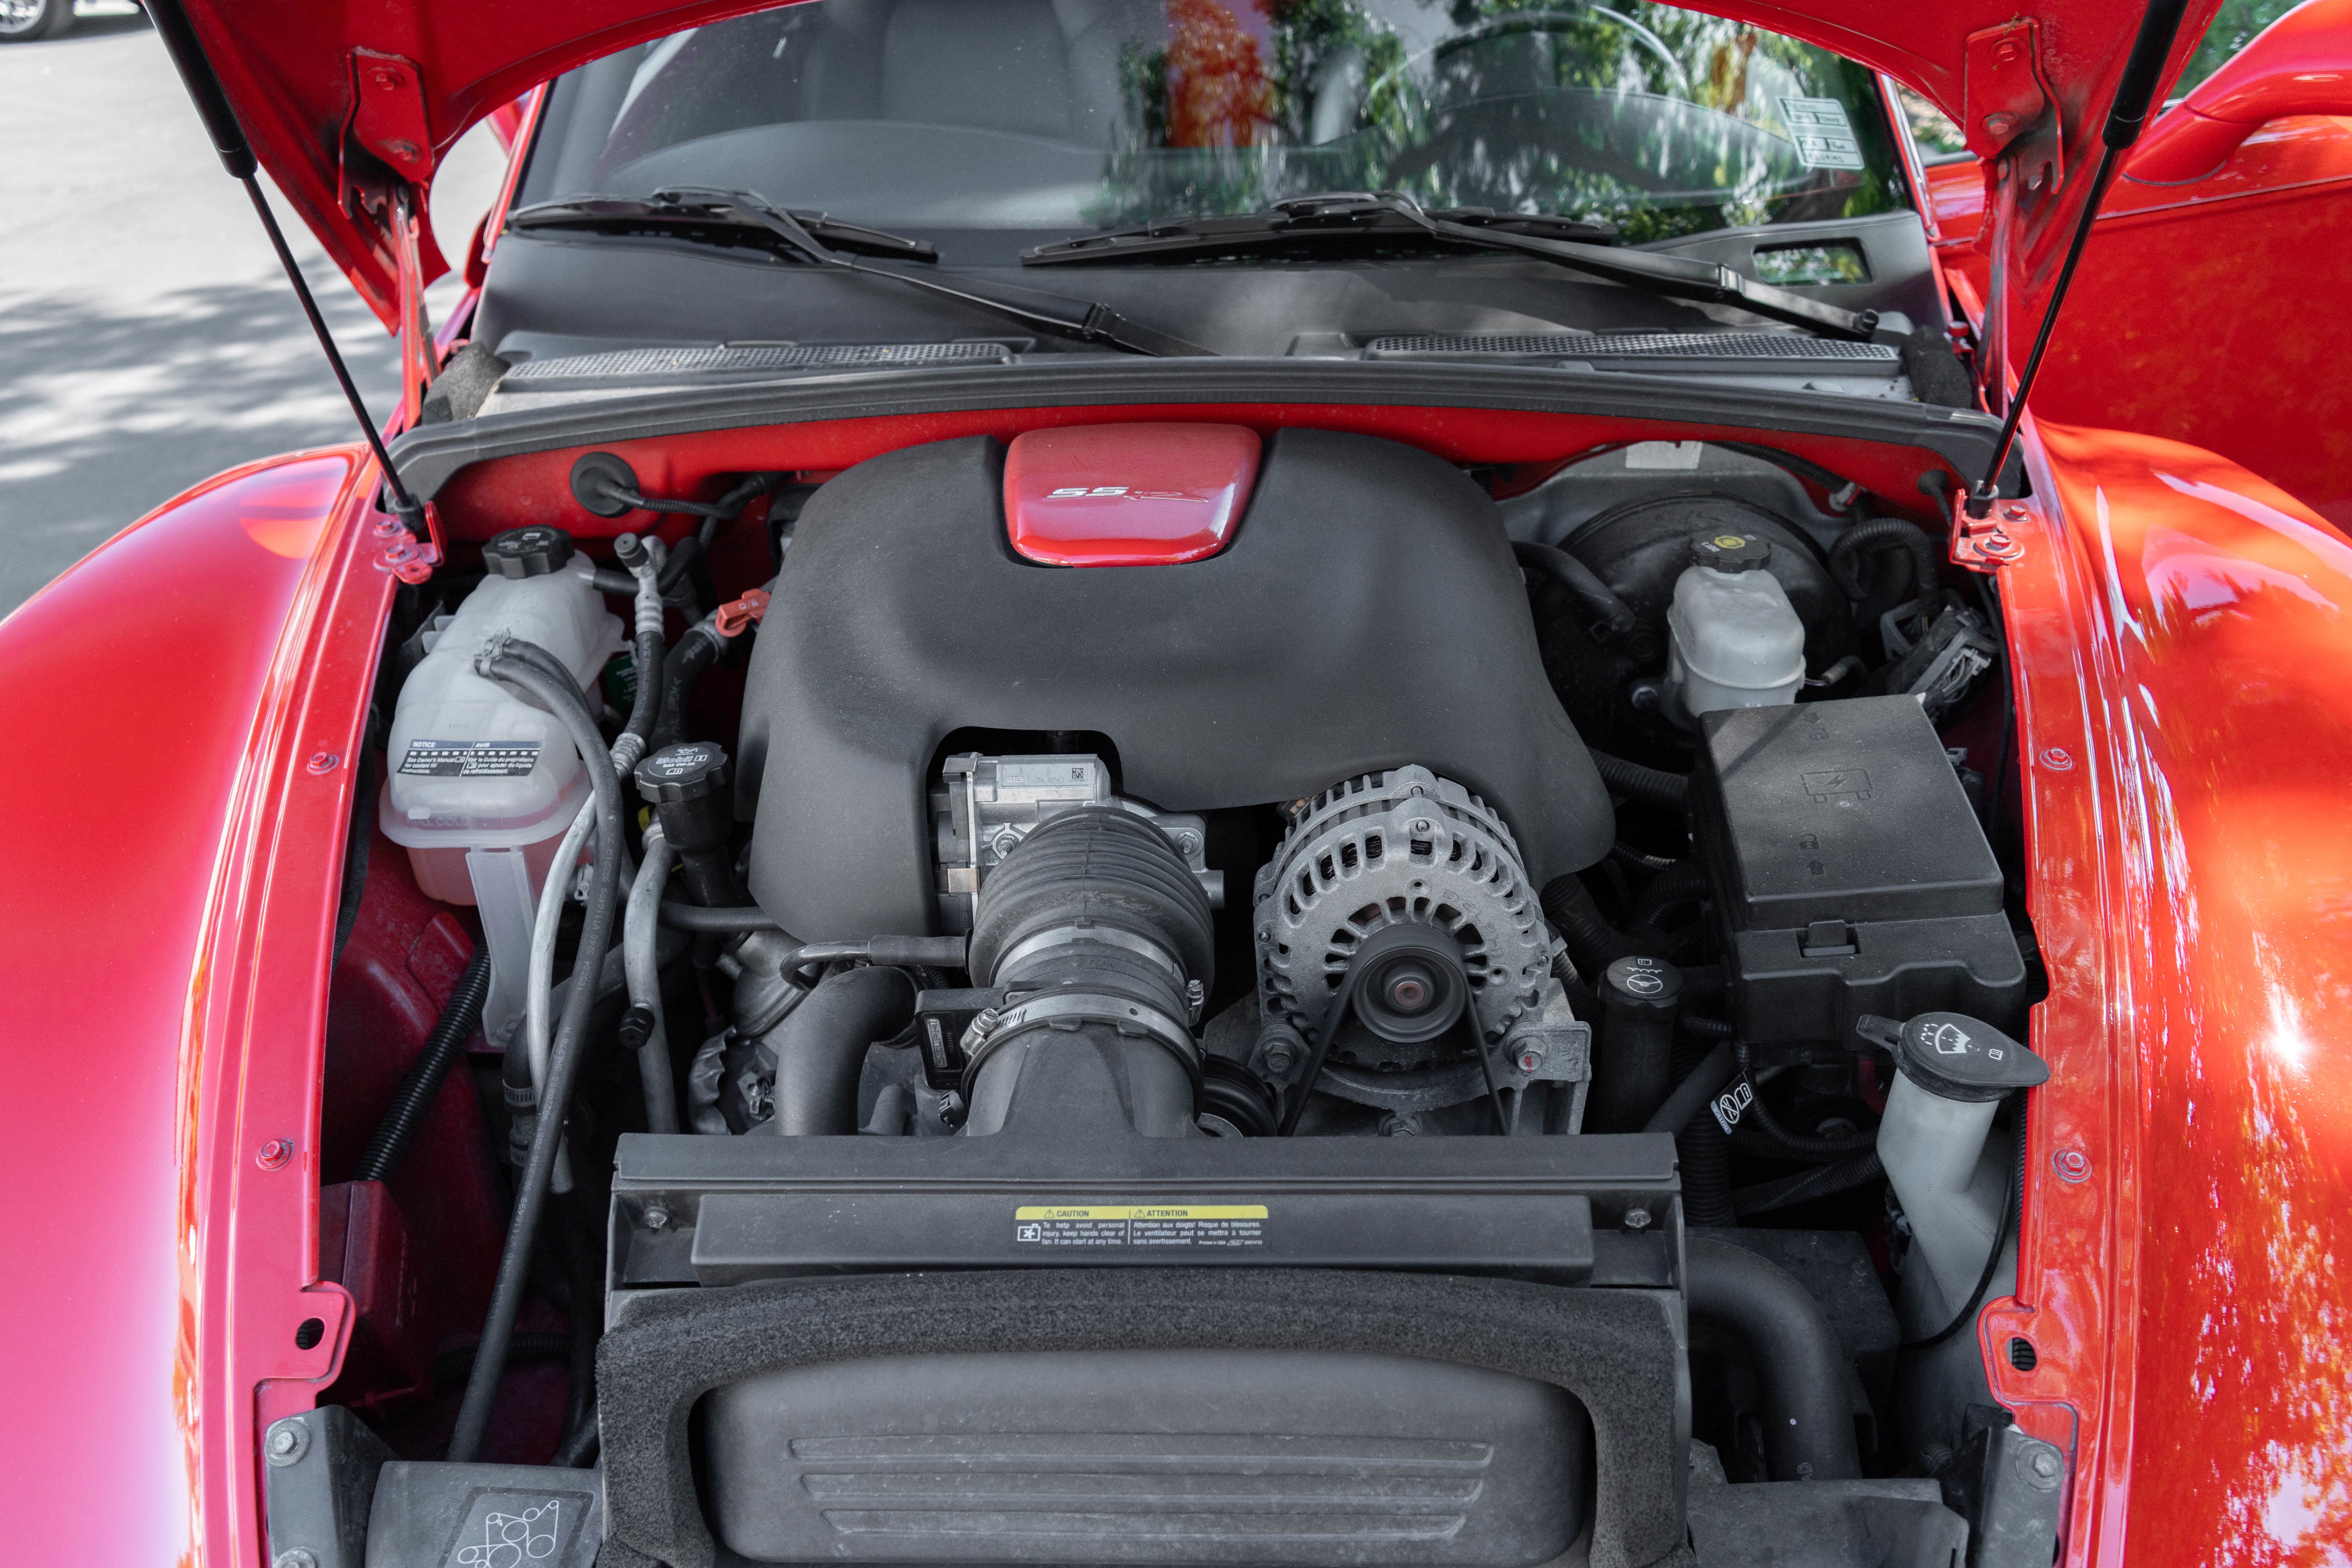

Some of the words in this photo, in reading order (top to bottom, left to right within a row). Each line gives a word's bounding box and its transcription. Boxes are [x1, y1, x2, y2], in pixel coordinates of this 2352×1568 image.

[656, 756, 694, 764] Mobil
[1440, 888, 1503, 958] DELPHI
[1713, 1107, 1728, 1131] NOTICE
